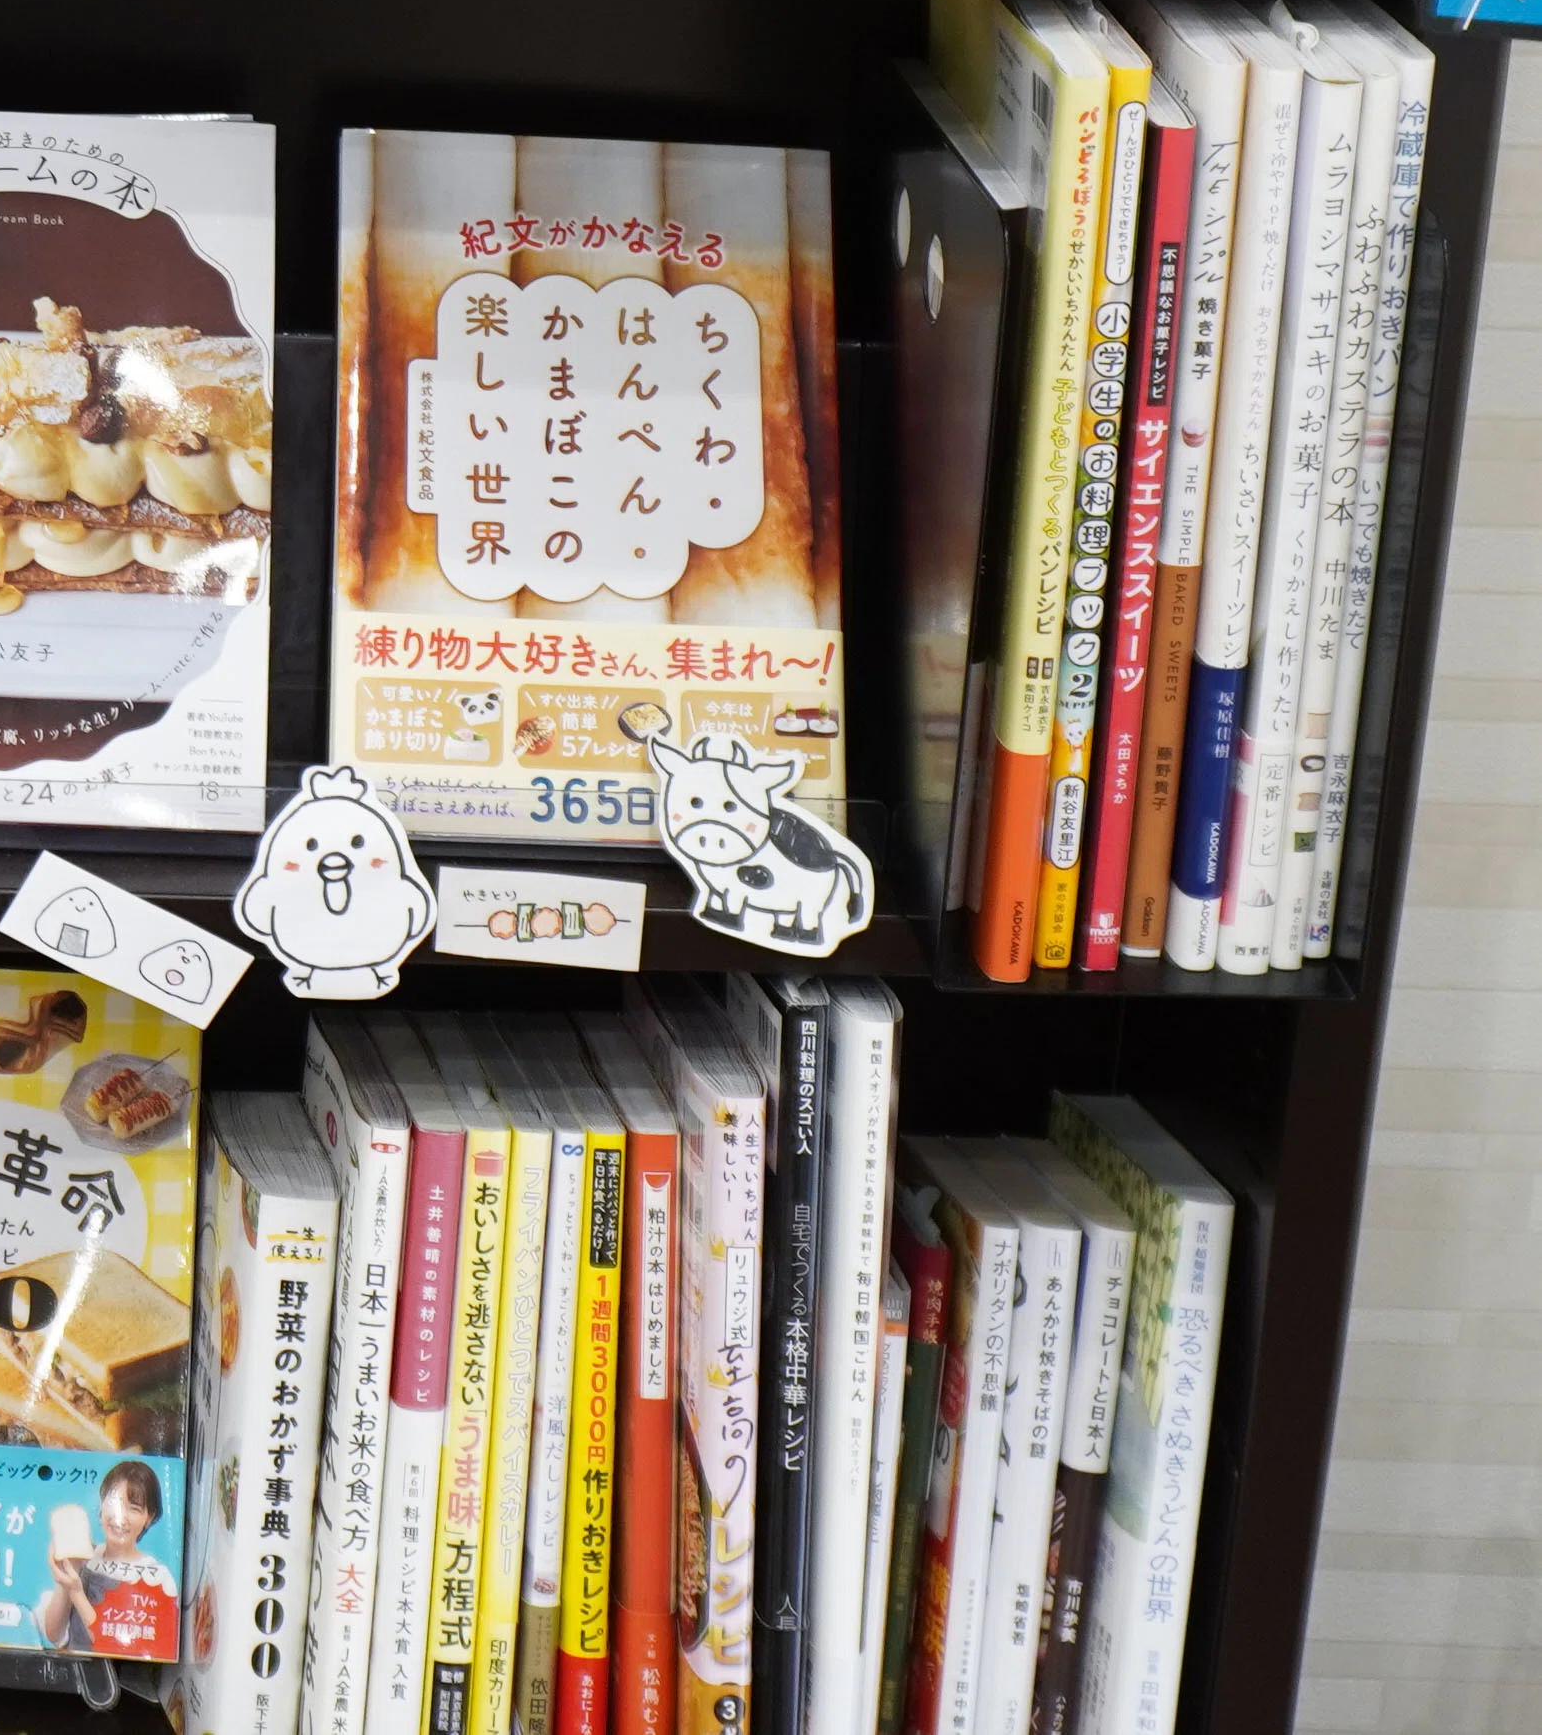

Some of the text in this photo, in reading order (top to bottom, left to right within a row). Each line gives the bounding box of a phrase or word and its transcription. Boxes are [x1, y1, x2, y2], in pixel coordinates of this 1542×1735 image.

[33, 213, 65, 227] Book
[458, 214, 725, 269] 紀文がかなえる
[1289, 131, 1349, 511] ムラヨシマサユキのお菓子
[465, 293, 512, 567] 楽しい世界
[543, 304, 585, 564] かまぼこの
[616, 306, 662, 561] はんぺん・
[694, 310, 738, 512] ちくわ・
[1324, 204, 1386, 527] ふわふわカステラの本
[1066, 302, 1132, 668] 小学生のお料理ブック
[1116, 416, 1170, 694] サイエンススイーツ
[462, 887, 518, 904] やきとり
[796, 1019, 817, 1155] 四川料理のスゴい人
[415, 1185, 445, 1404] 土井善晴の素材のレシピ
[979, 1239, 1011, 1412] ナポリタンの不思議
[1085, 1276, 1123, 1459] チョコレートと日本人
[250, 1279, 310, 1680] 野菜のおかず事典 300
